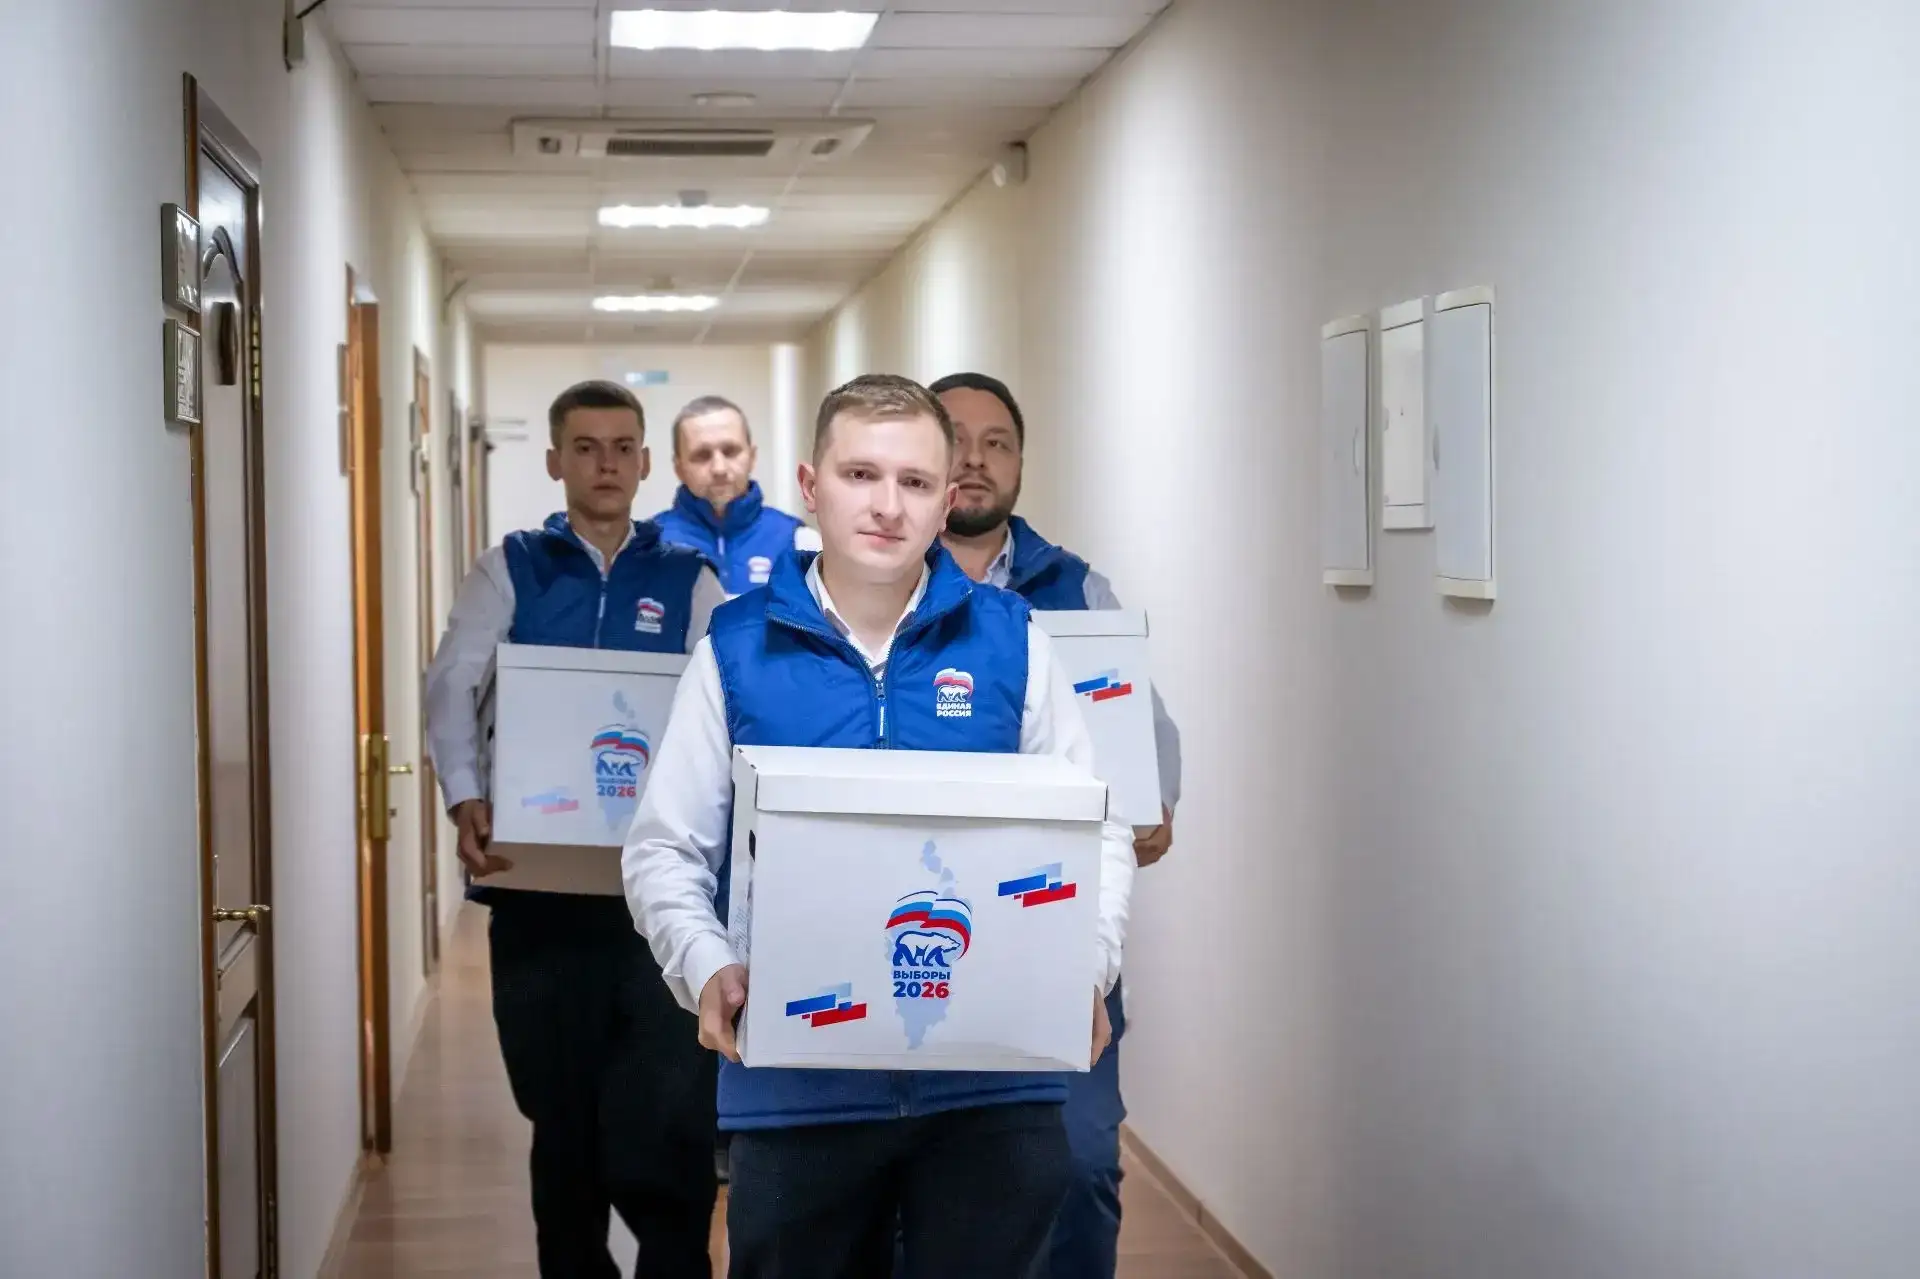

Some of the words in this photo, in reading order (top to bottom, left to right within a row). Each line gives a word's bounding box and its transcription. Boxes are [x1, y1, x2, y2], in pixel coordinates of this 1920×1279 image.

[597, 785, 636, 797] 2026
[893, 970, 950, 980] ВЫБОРЫ
[893, 981, 949, 998] 2026
